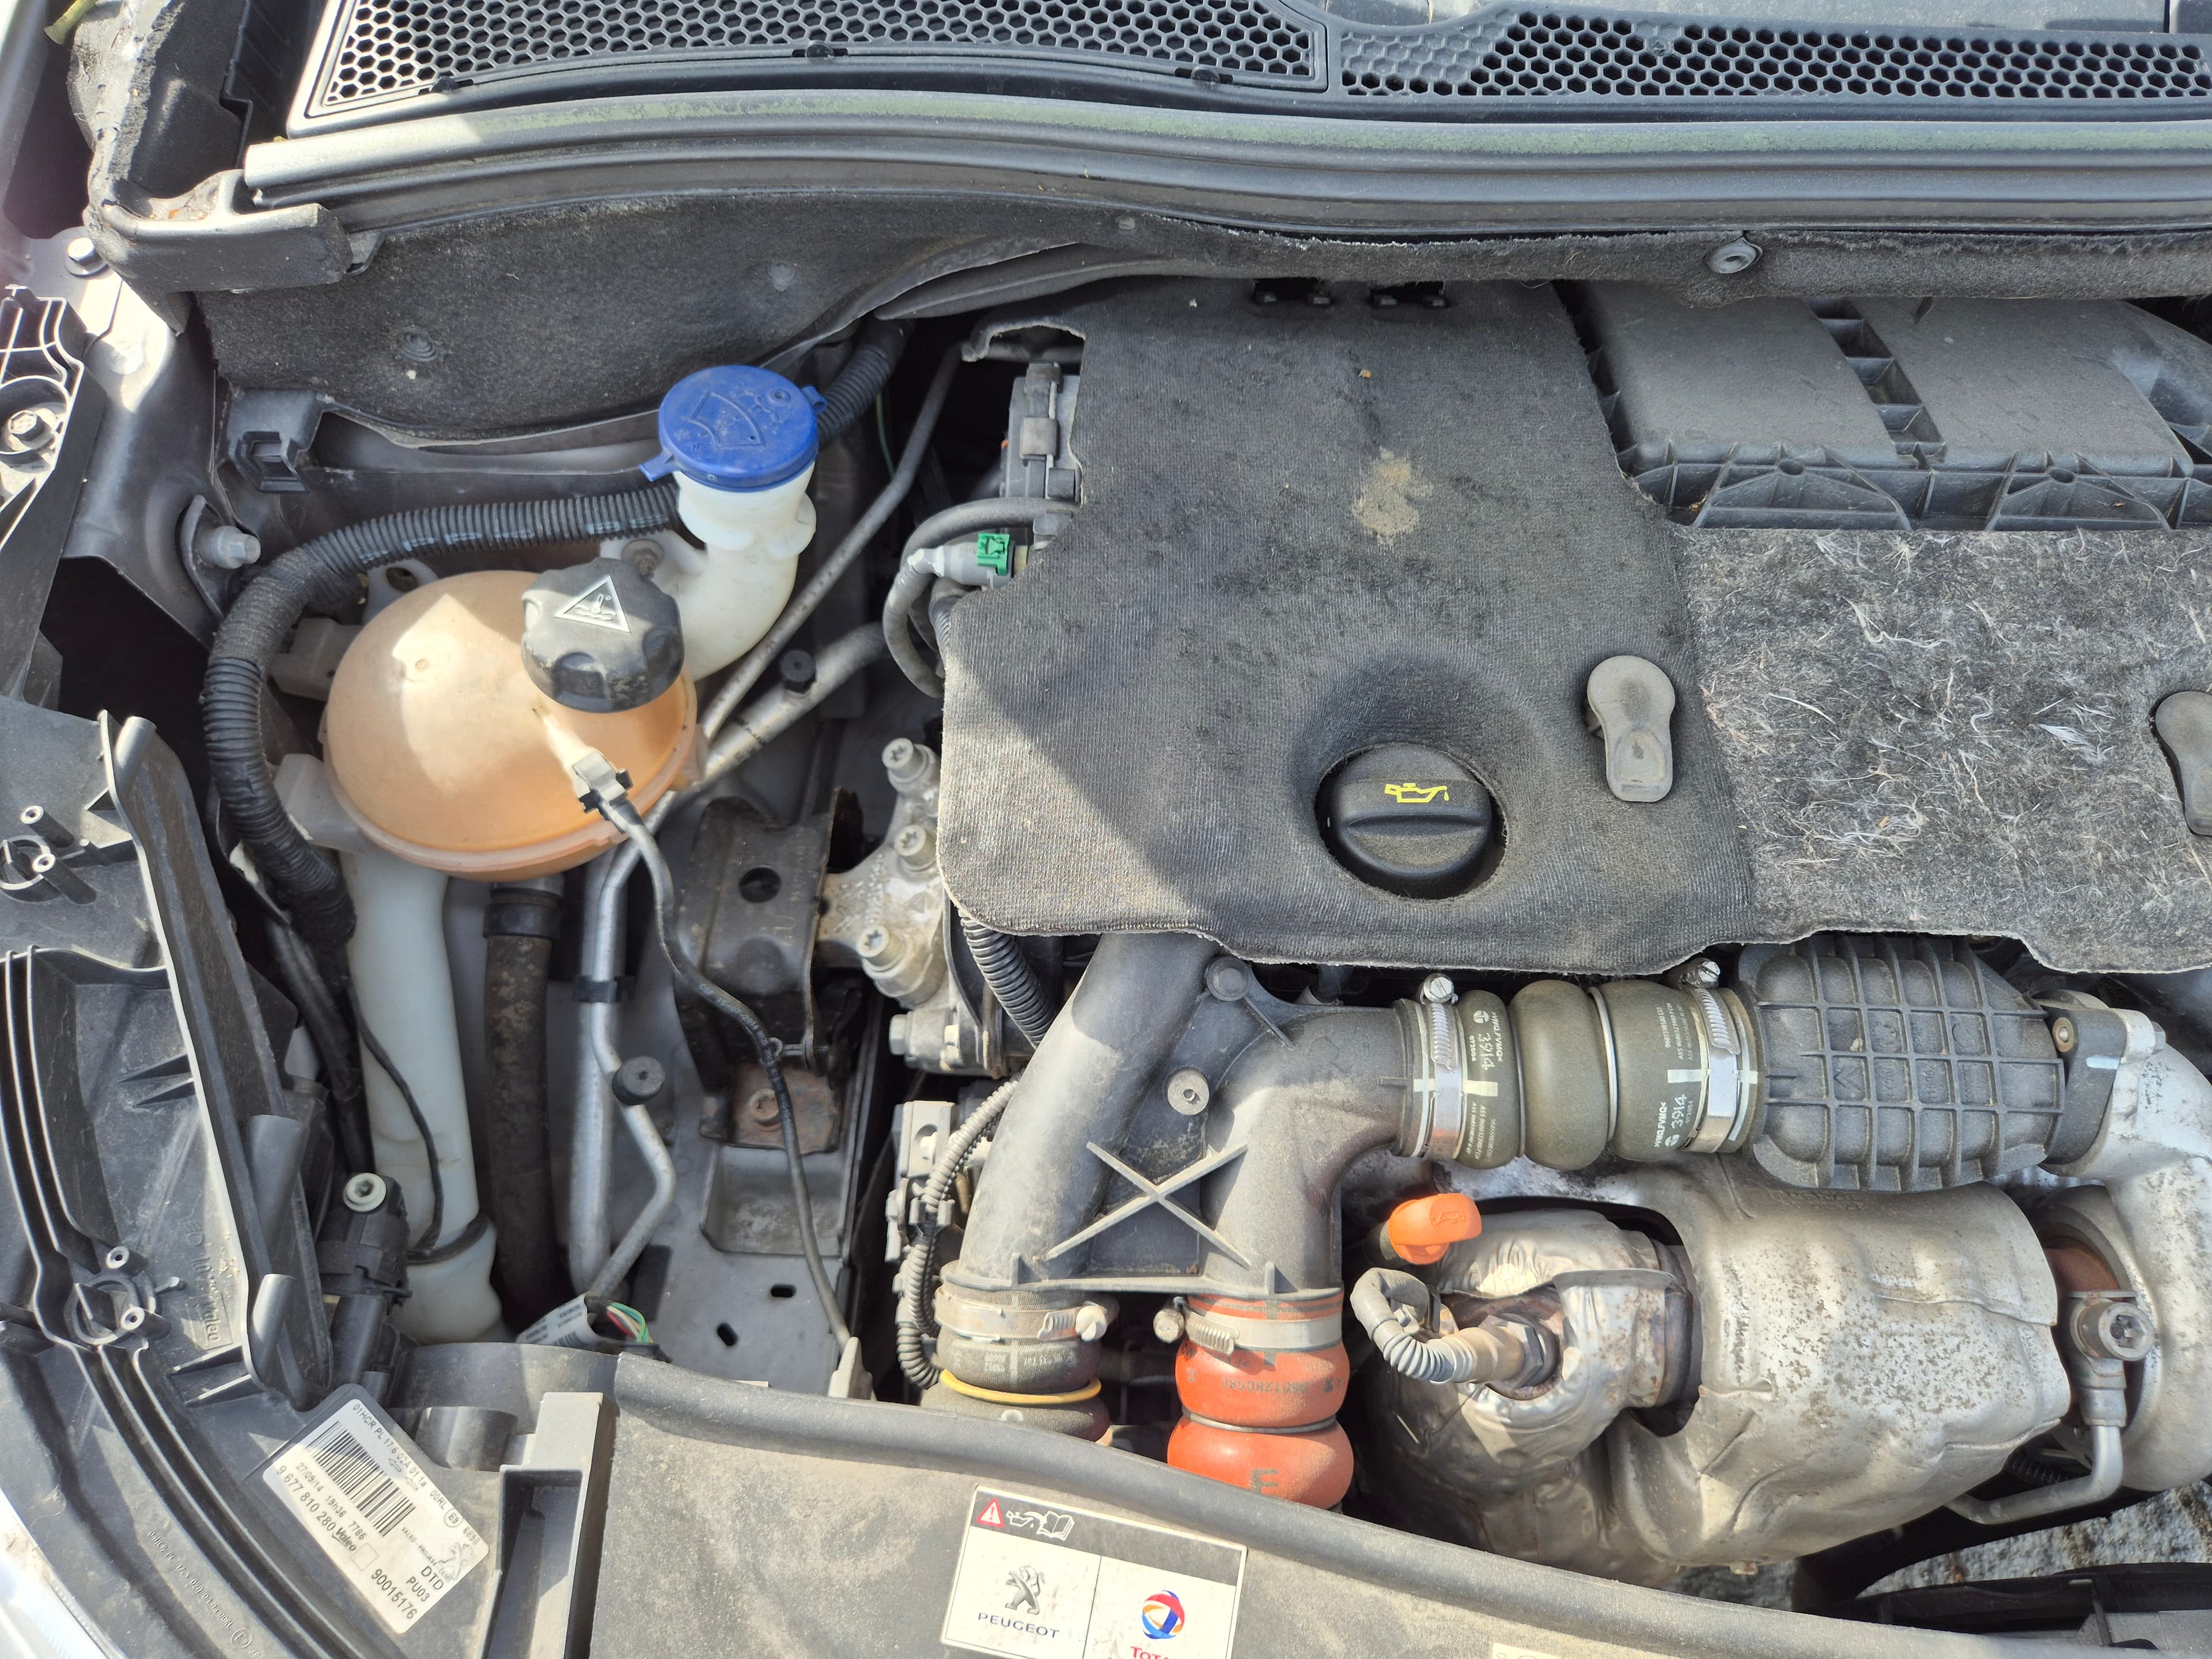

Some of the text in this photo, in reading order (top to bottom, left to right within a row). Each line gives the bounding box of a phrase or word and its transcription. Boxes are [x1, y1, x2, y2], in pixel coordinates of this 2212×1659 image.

[352, 1403, 377, 1429] 01HCR
[373, 1427, 386, 1439] PL
[396, 1452, 412, 1469] 02A
[429, 1490, 448, 1509] 00RL
[447, 1512, 460, 1525] E9
[275, 1464, 338, 1532] 9 677 810 280
[295, 1461, 325, 1493] 27/09/14
[324, 1494, 347, 1518] 19h36
[334, 1527, 359, 1552] Valeo
[369, 1568, 419, 1620] 90015176
[404, 1576, 431, 1603] PU03
[420, 1566, 445, 1592] DTD
[978, 1612, 1060, 1638] PEUGEOT
